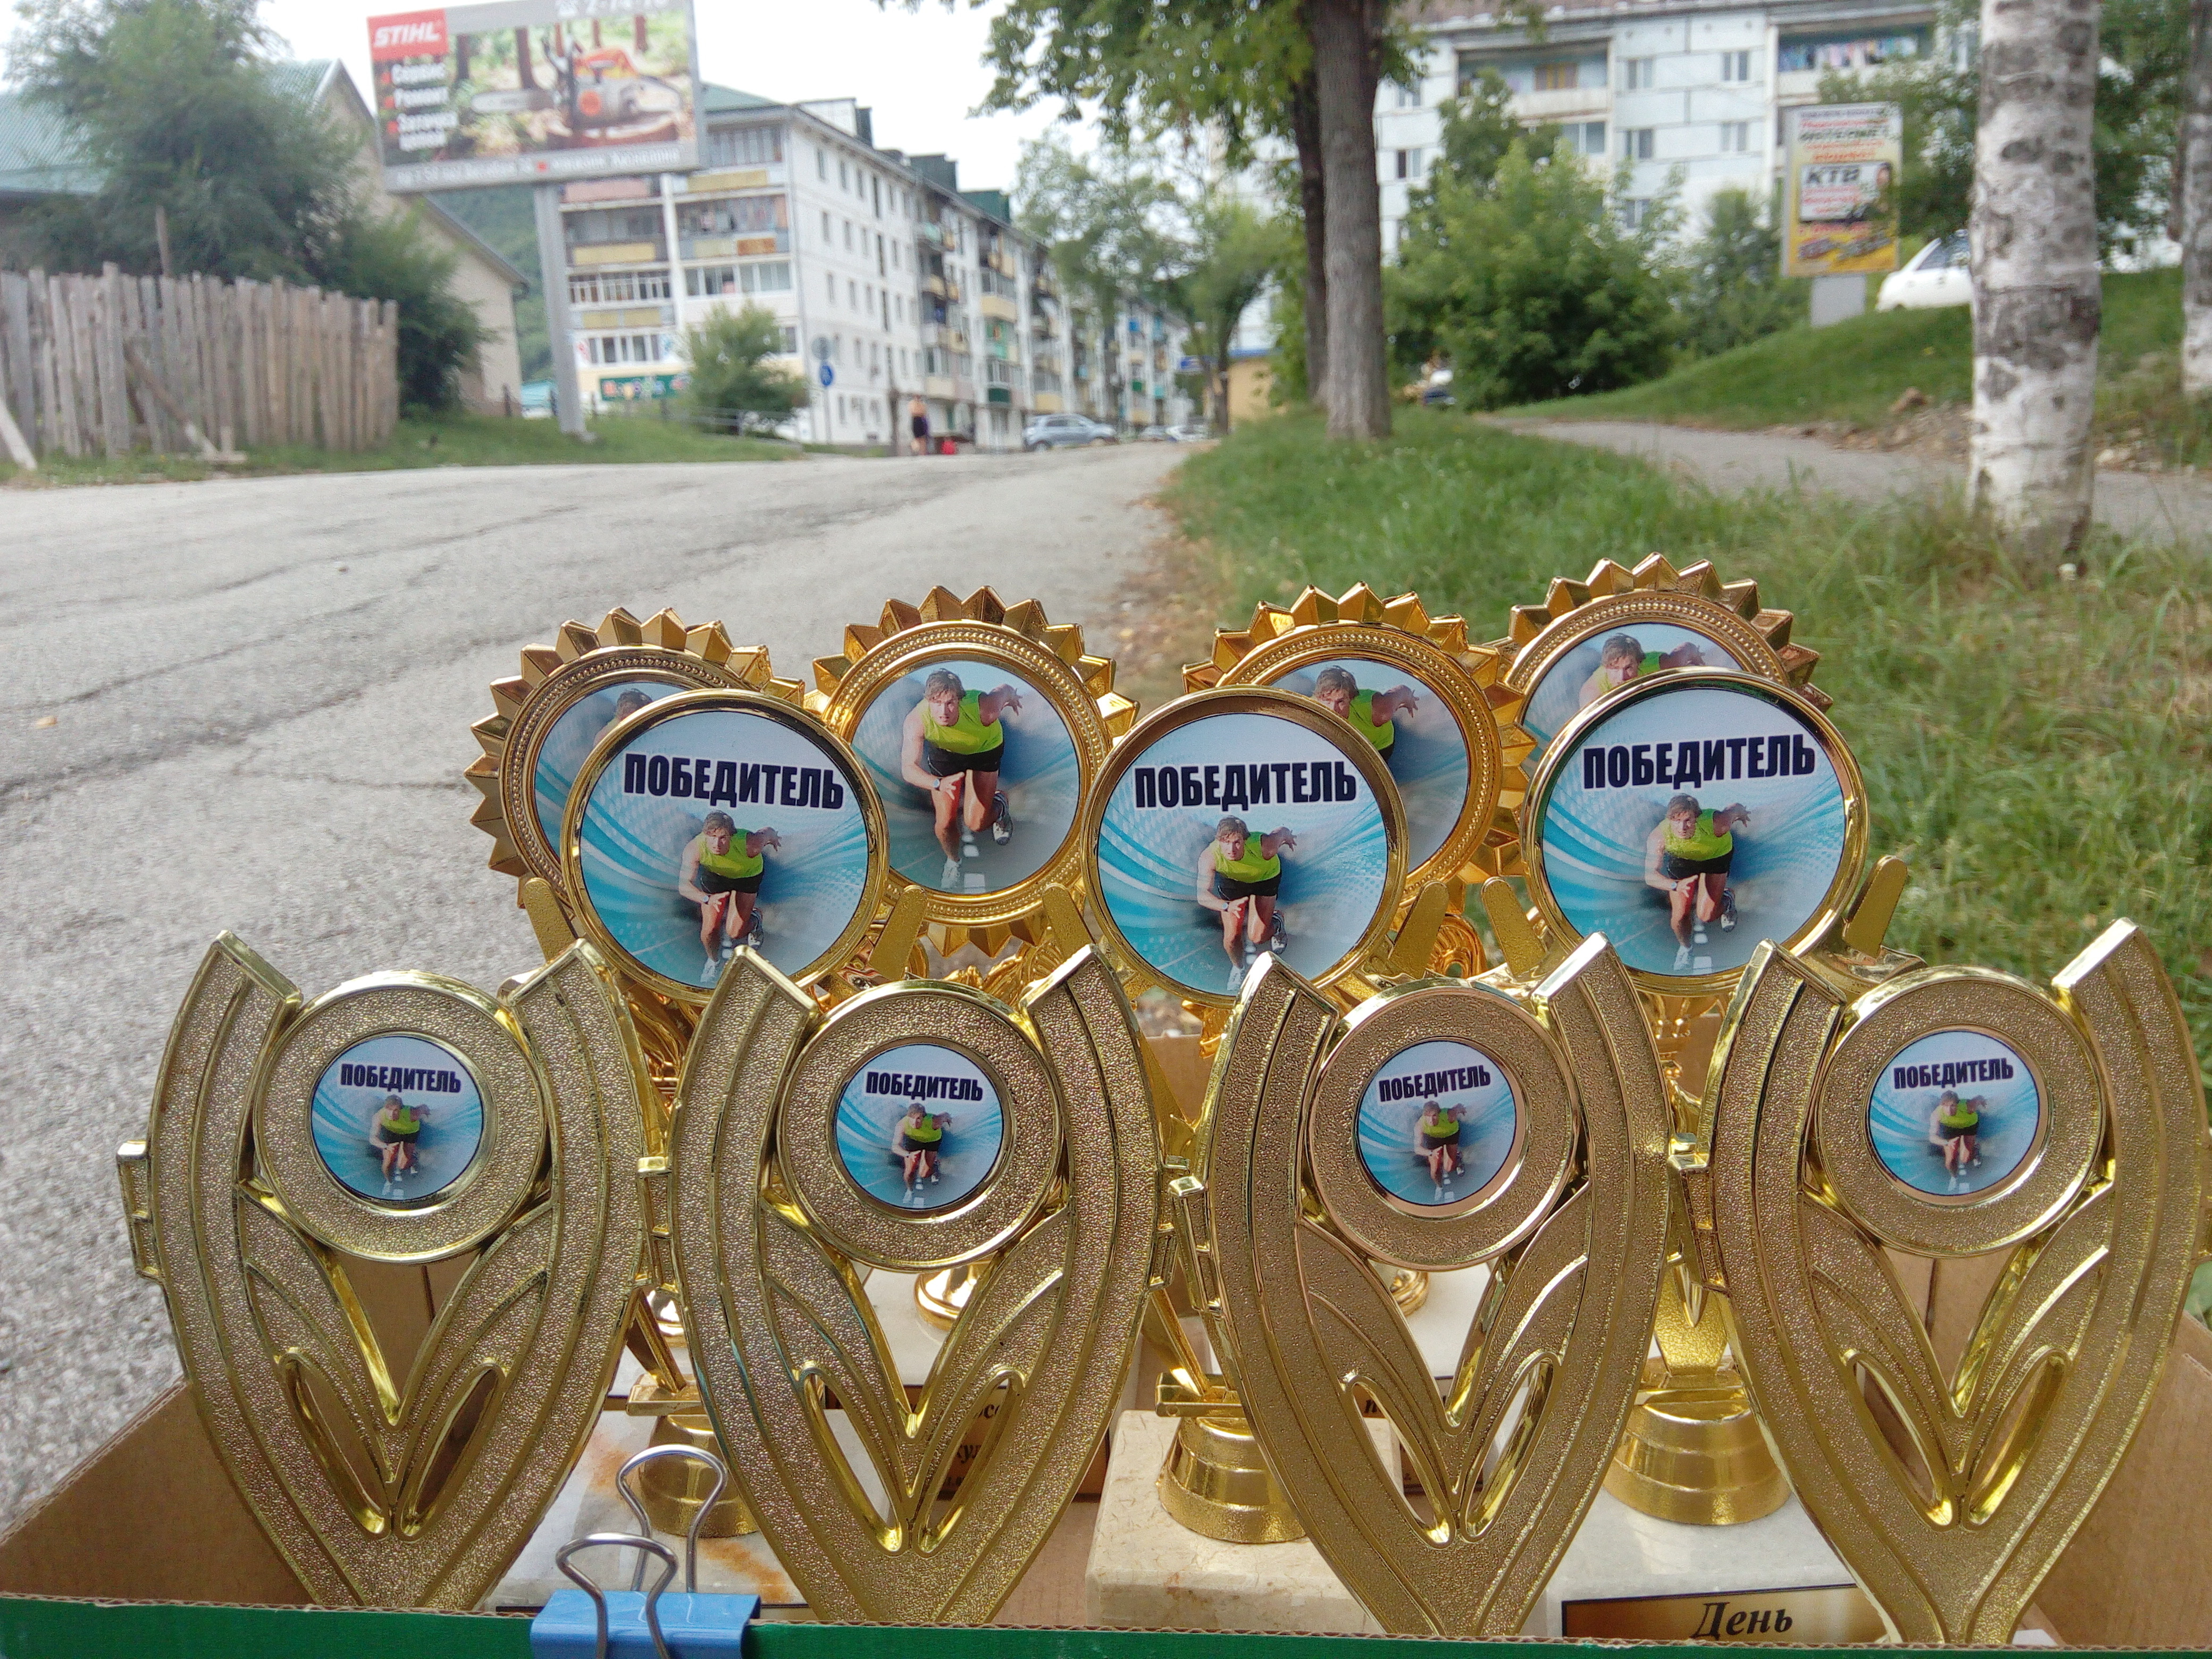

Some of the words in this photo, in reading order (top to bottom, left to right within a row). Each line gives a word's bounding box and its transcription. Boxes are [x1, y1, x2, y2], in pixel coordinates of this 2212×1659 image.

[374, 22, 440, 47] STIHL
[1583, 734, 1815, 790] ПОБЕДИТЕЛЬ
[624, 753, 844, 809] ПОБЕДИТЕЛЬ
[1135, 761, 1356, 811] ПОБЕДИТЕЛЬ
[340, 1063, 461, 1093] ПОБЕДИТЕЛЬ
[866, 1071, 983, 1101] ПОБЕДИТЕЛЬ
[1379, 1065, 1490, 1102] ПОБЕДИТЕЛЬ
[1894, 1058, 2014, 1089] ПОБЕДИТЕЛЬ
[1689, 1601, 1794, 1640] День
